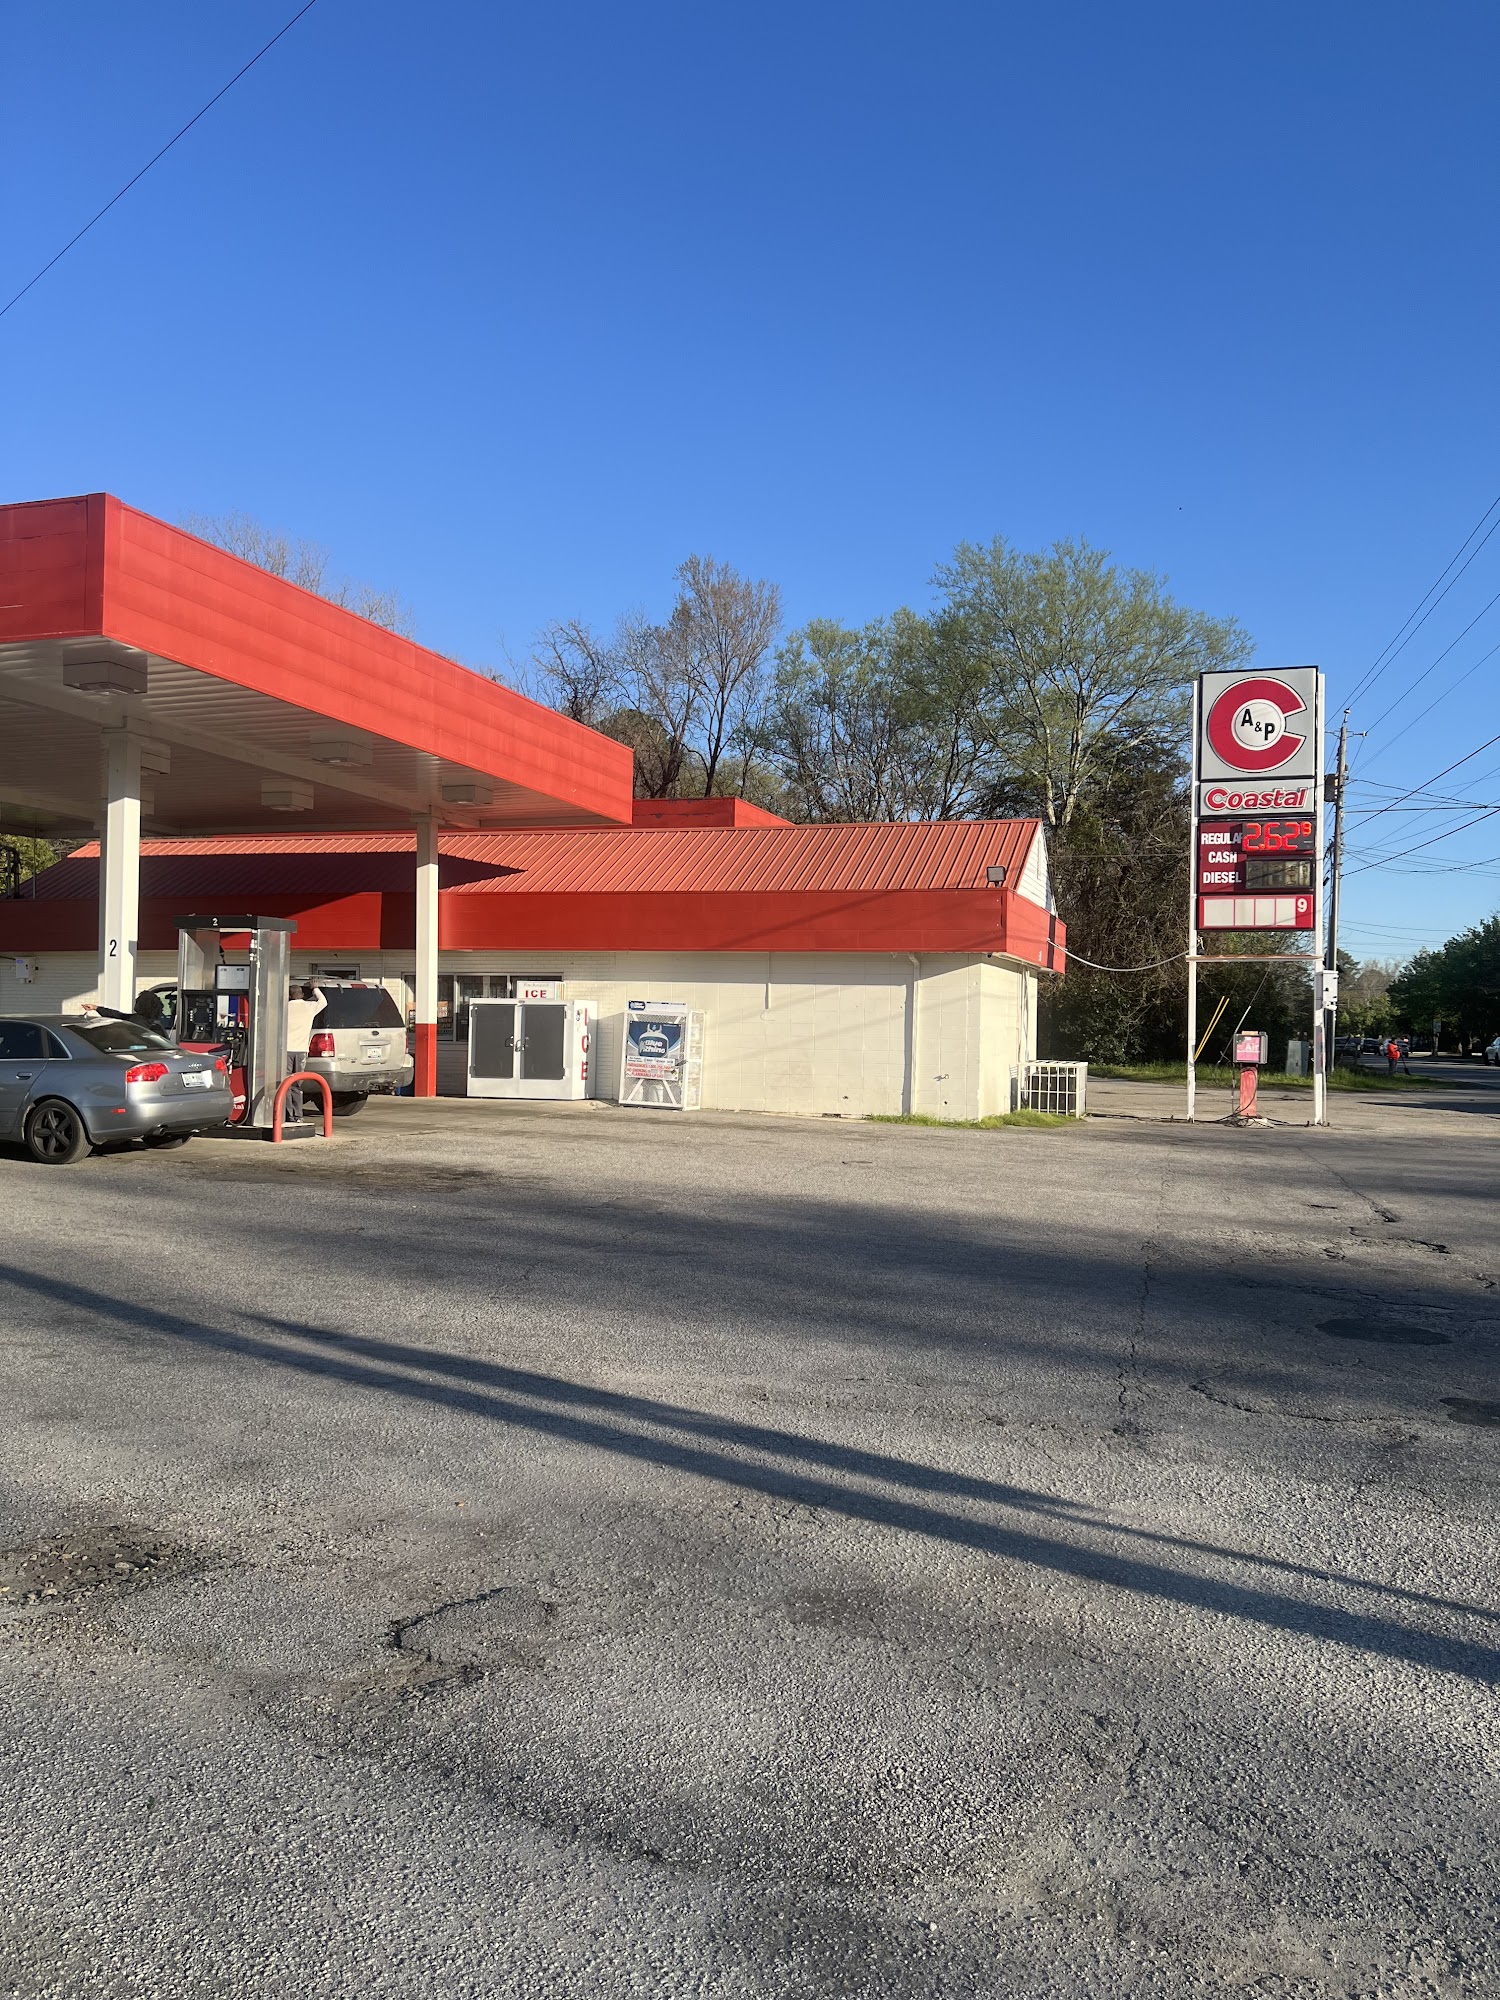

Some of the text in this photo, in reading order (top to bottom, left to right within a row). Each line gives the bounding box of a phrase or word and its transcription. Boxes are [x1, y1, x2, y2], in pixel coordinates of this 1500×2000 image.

[1241, 709, 1275, 740] A&P
[1205, 787, 1308, 811] Coastal
[1208, 851, 1237, 863] CASH
[1203, 871, 1242, 884] DIESEL
[1297, 898, 1308, 913] 9
[109, 939, 117, 957] 2
[525, 989, 547, 998] ICE
[581, 1008, 589, 1080] ICE
[1245, 1043, 1259, 1051] Air
